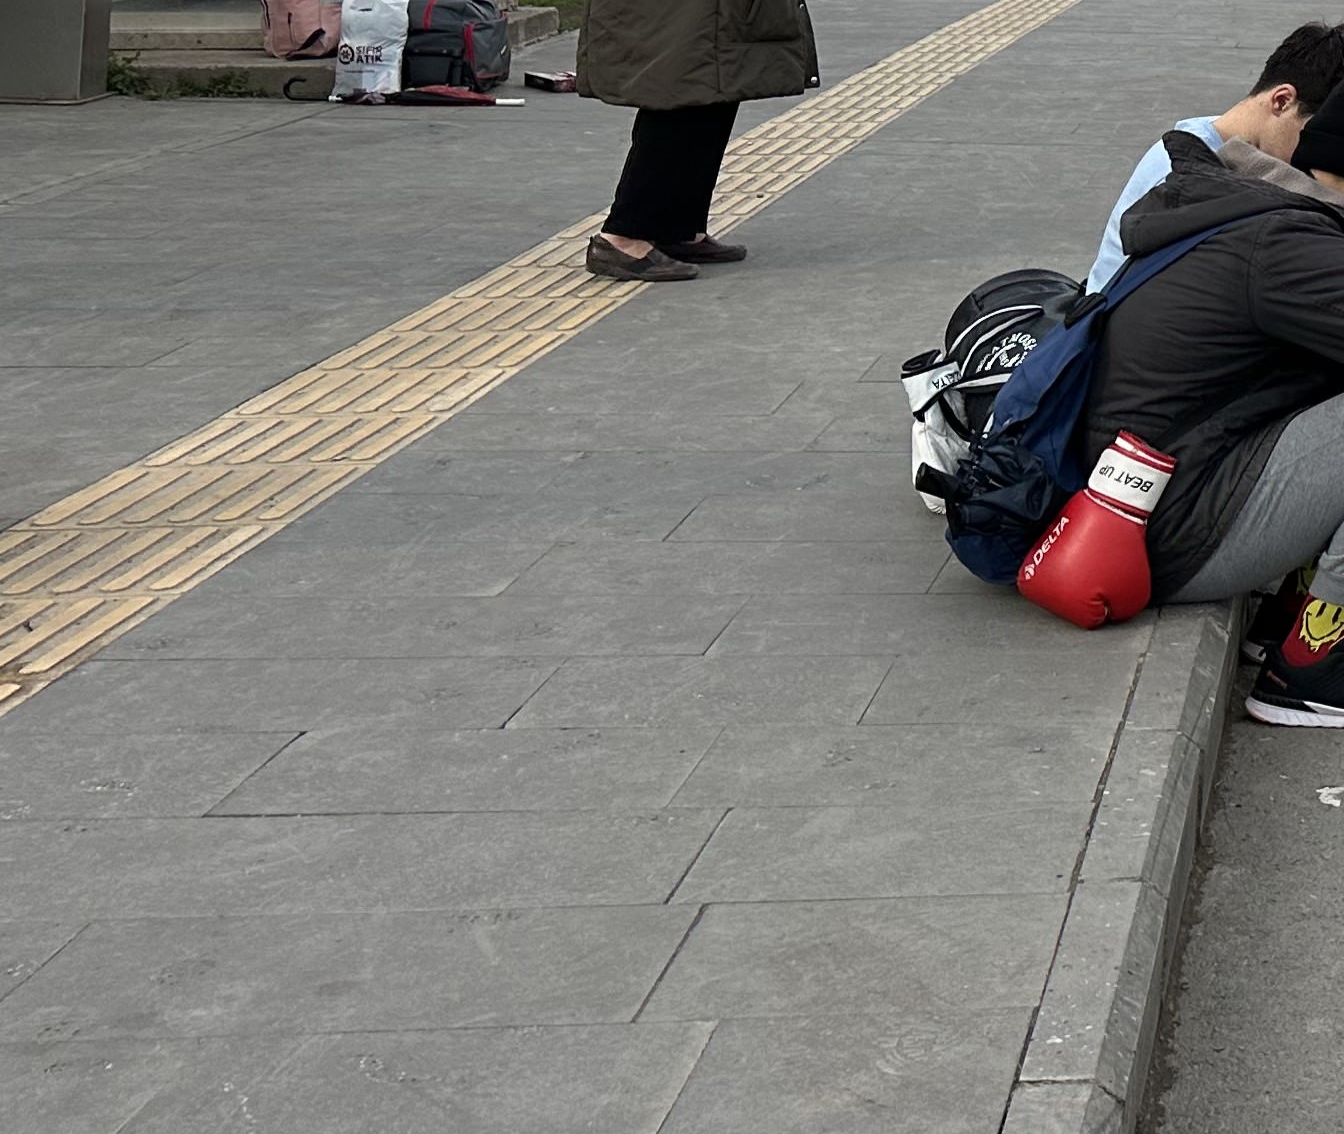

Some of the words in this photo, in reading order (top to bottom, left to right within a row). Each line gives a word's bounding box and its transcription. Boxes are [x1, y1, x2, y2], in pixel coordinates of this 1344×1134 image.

[356, 55, 383, 64] ATIK
[1099, 464, 1115, 479] UP
[1114, 470, 1154, 493] BEAT
[1033, 516, 1070, 566] DELTA
